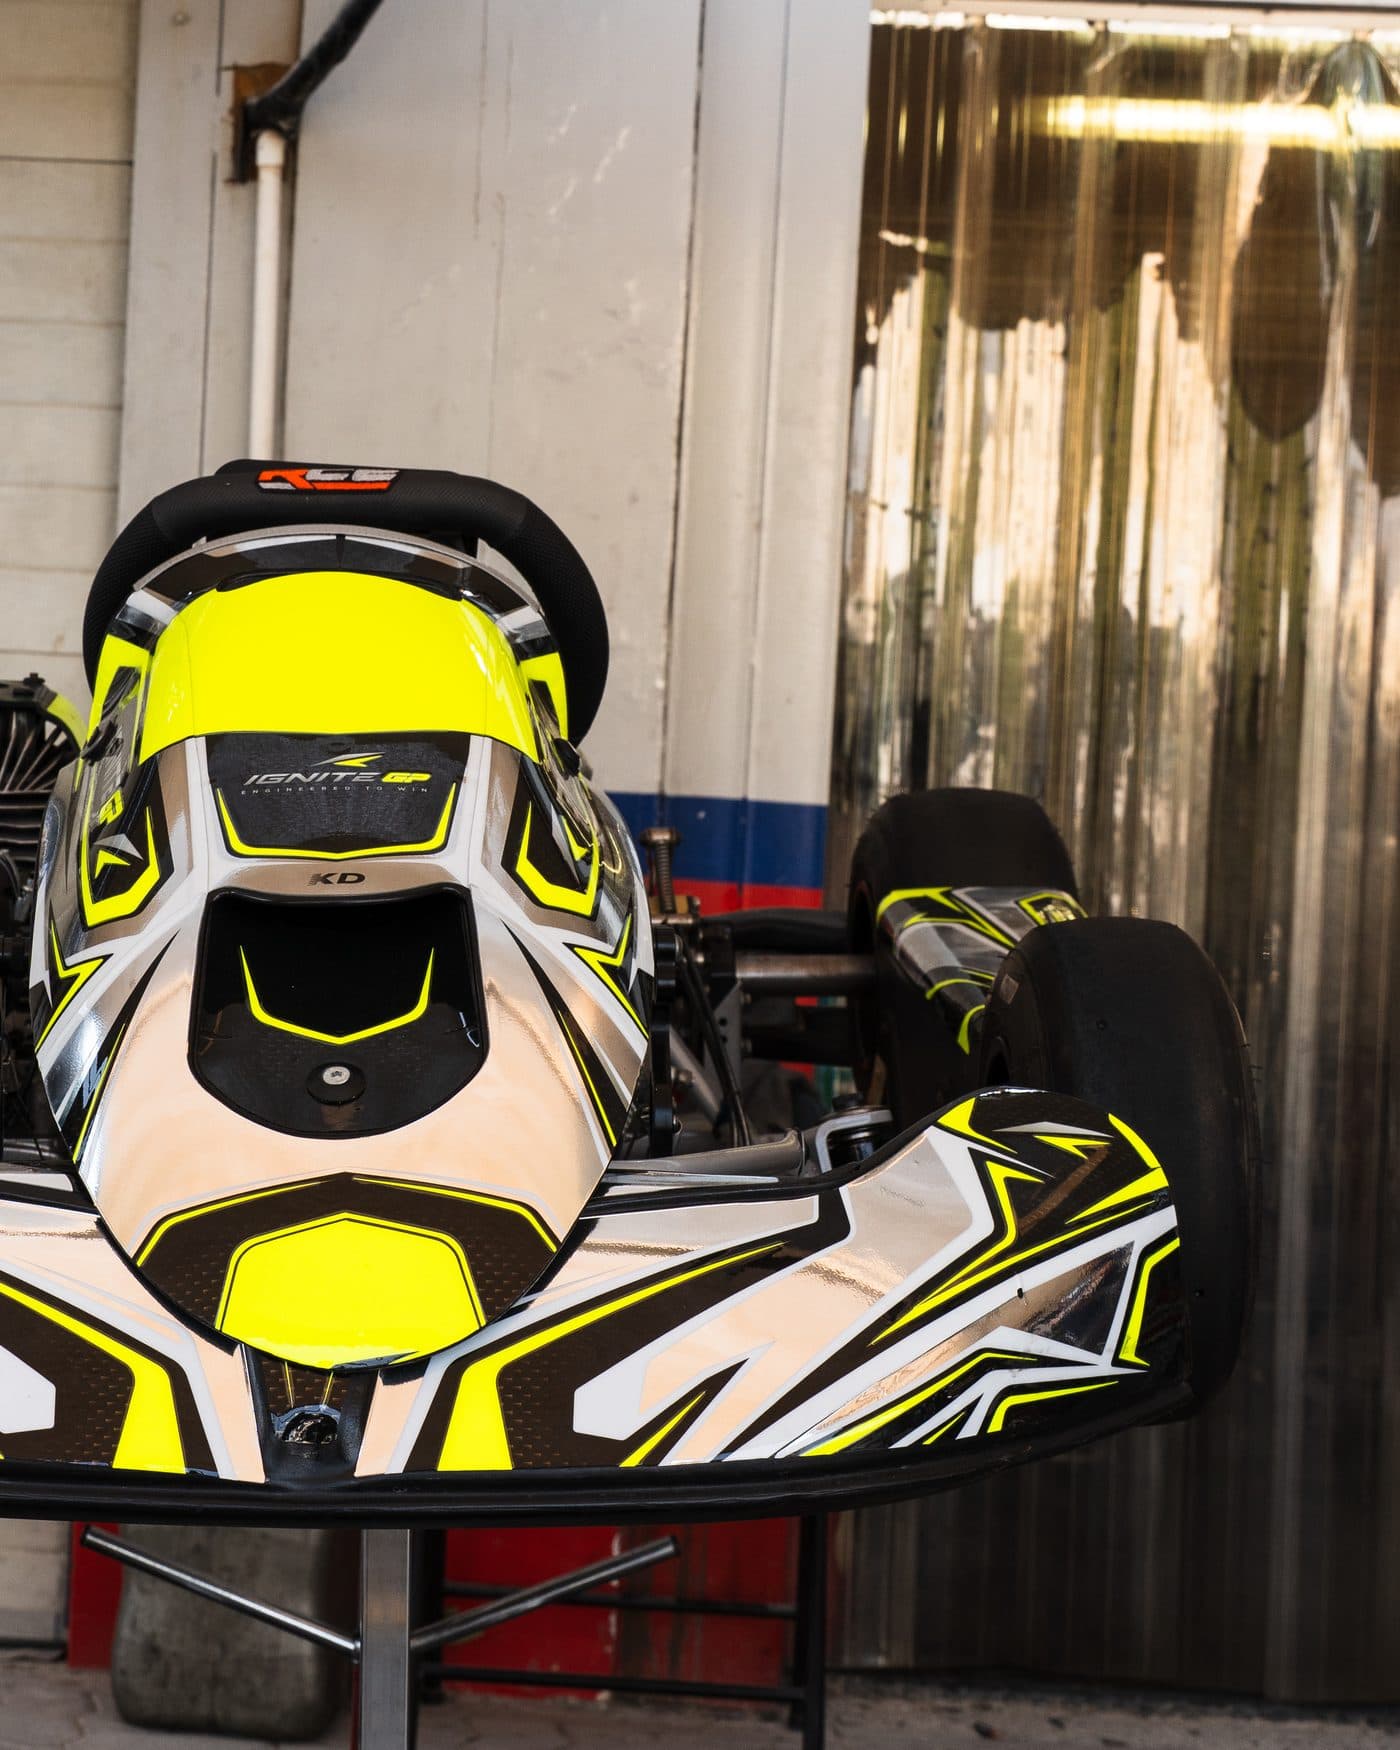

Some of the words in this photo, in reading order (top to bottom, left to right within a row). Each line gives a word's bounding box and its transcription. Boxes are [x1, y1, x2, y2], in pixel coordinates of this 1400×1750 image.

[243, 771, 382, 785] IGNITE
[381, 771, 432, 783] GP
[240, 785, 351, 795] ENGINEERED
[306, 872, 366, 887] KD
